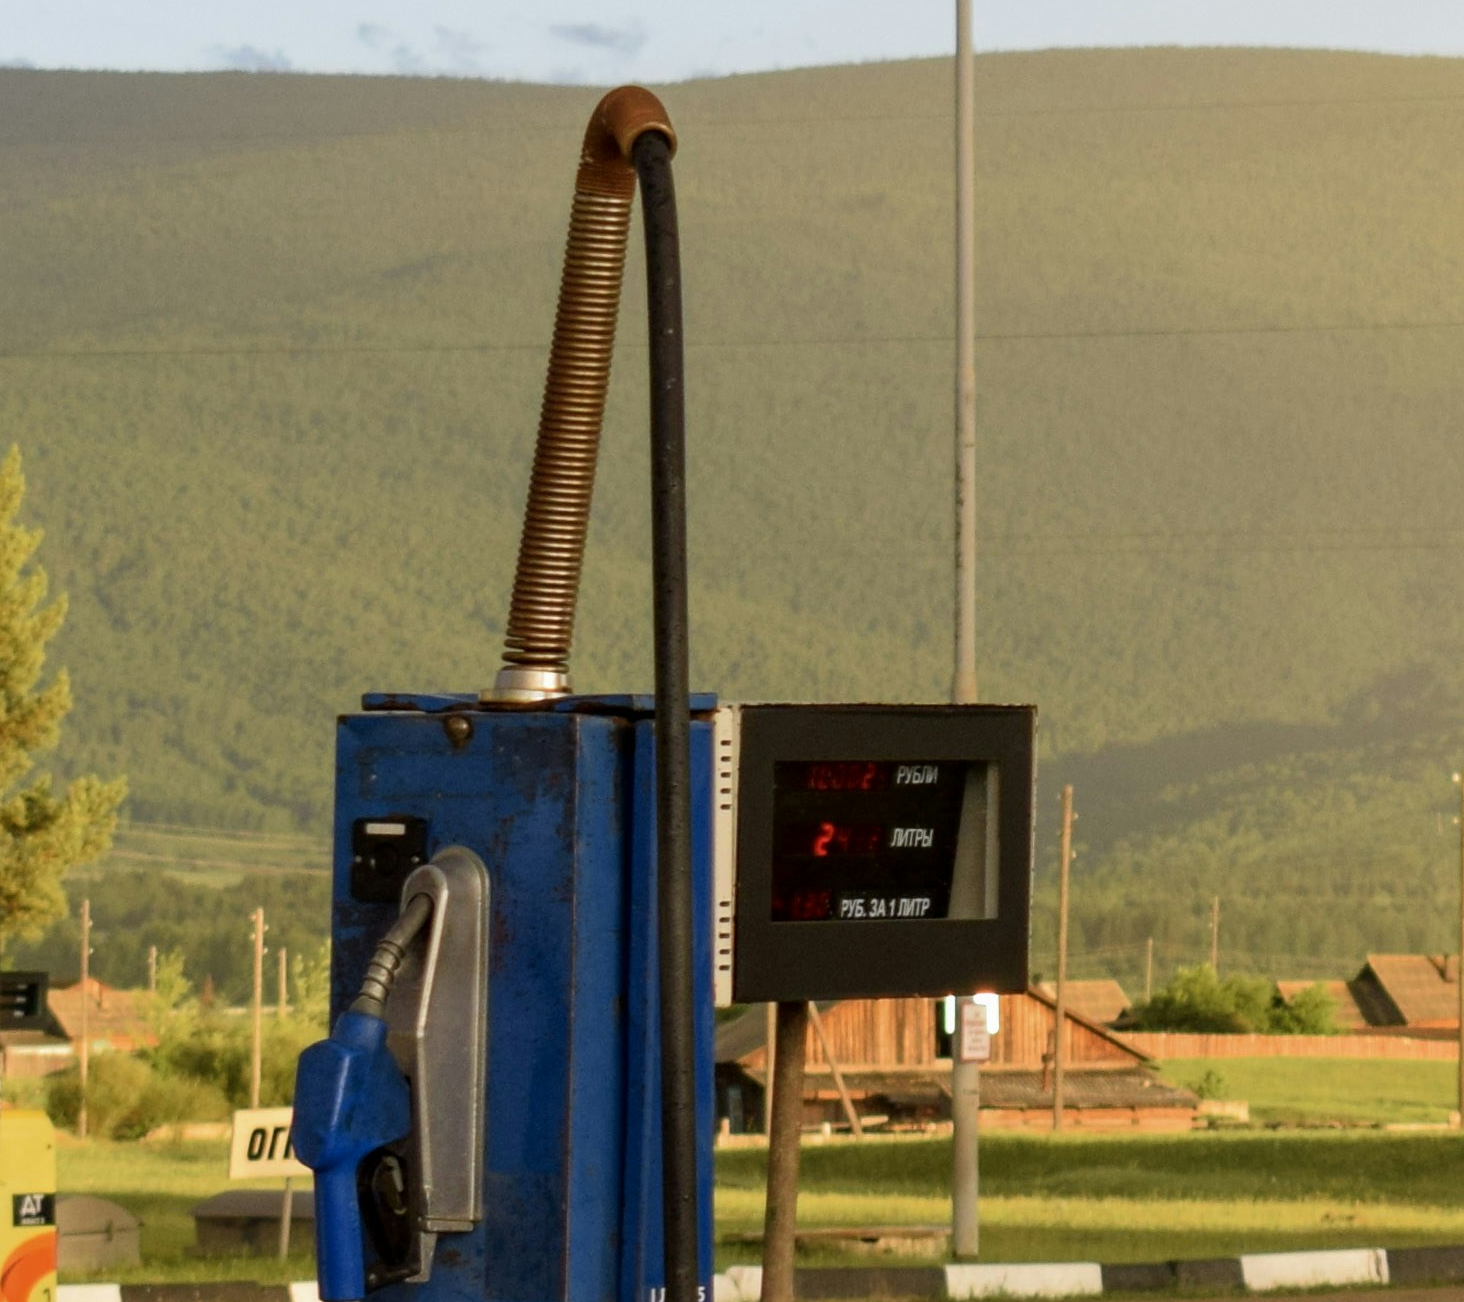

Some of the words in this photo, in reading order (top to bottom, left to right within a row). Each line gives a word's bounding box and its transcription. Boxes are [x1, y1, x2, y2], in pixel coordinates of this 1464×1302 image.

[896, 765, 938, 784] РУБЛИ
[891, 827, 934, 847] ЛИТРЫ
[840, 899, 867, 918] РУБ.
[869, 898, 886, 916] ЗА
[889, 899, 896, 916] 1
[897, 898, 931, 916] ЛИТР
